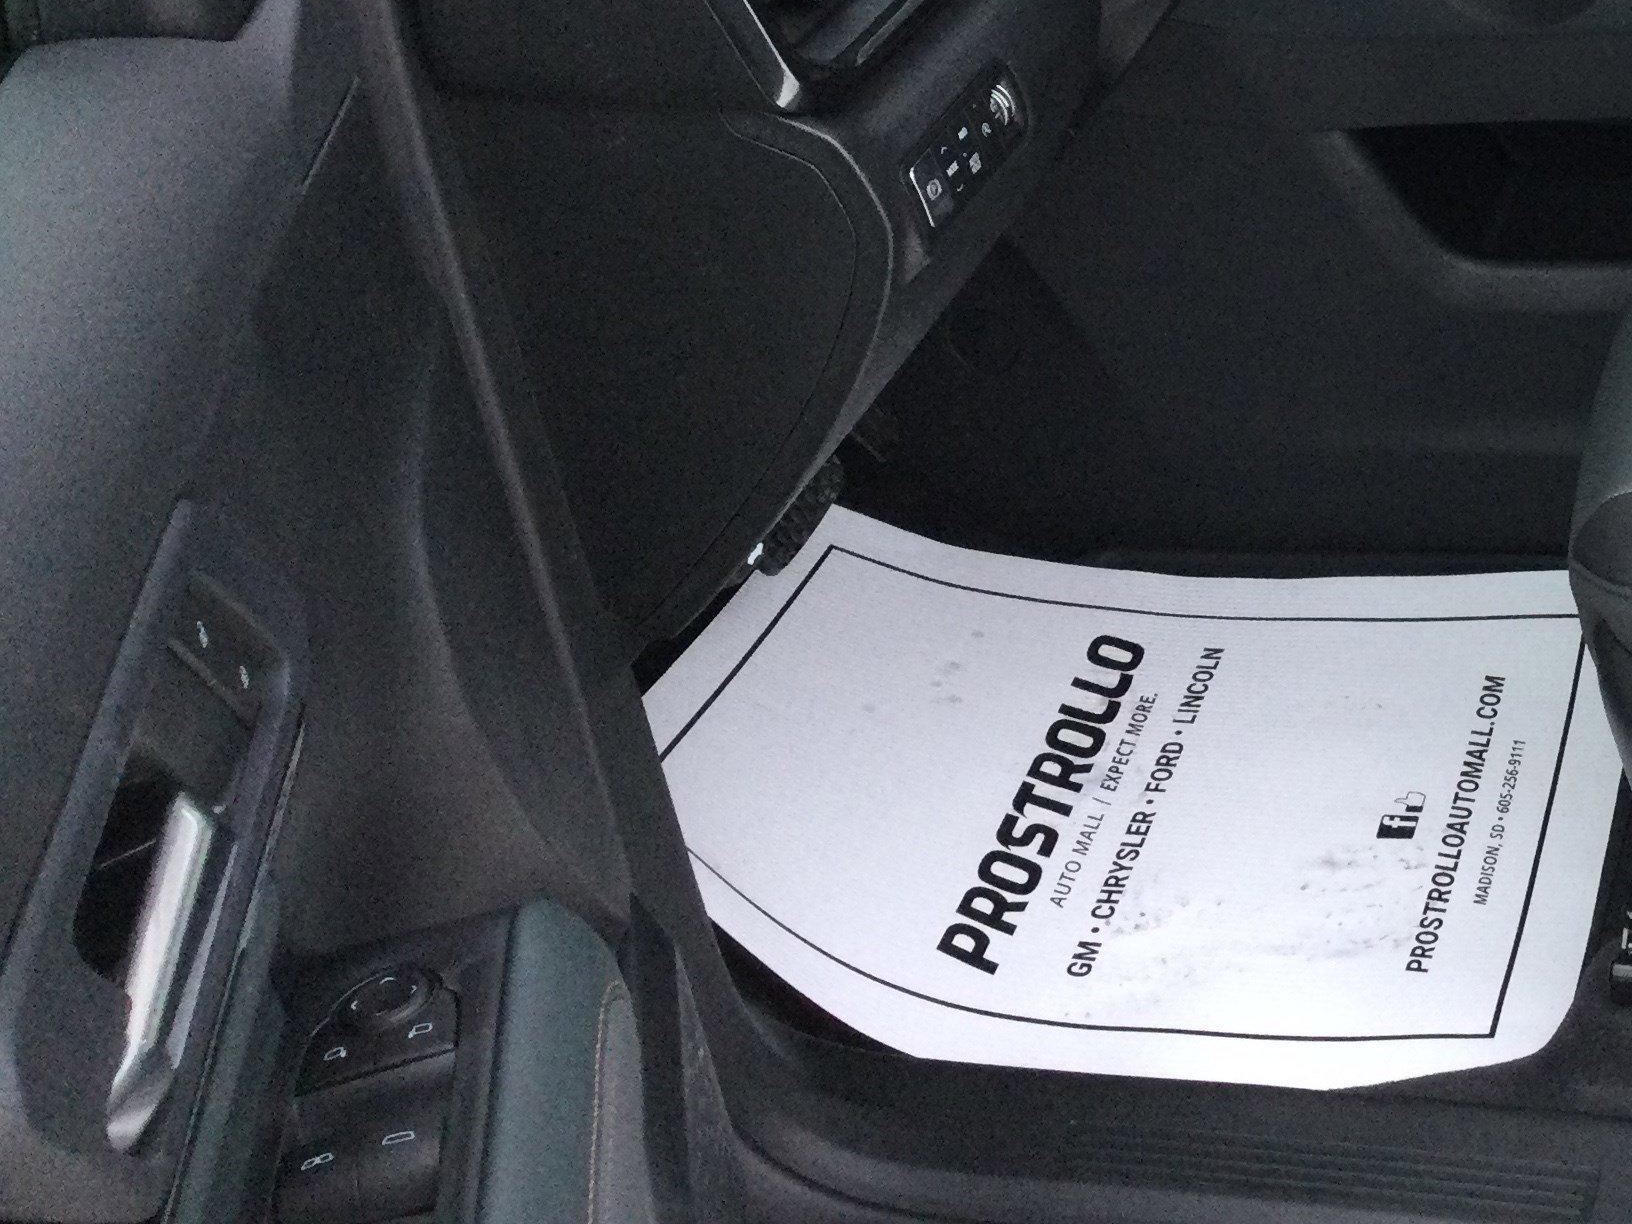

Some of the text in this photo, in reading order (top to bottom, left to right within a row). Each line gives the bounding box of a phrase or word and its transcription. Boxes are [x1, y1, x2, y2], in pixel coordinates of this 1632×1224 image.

[936, 634, 1145, 976] PROSTROLLO
[1050, 860, 1082, 908] AUTO
[1072, 813, 1105, 855] MALL
[1100, 738, 1137, 792] EXPECT
[1125, 693, 1158, 737] MORE.
[1066, 647, 1225, 977] GM CHRYSLER FORD LINCOLN
[1405, 675, 1506, 973] PROSTROLLOAUTOMALL.COM
[1474, 739, 1526, 905] MADISON, SD 605-256-9111
